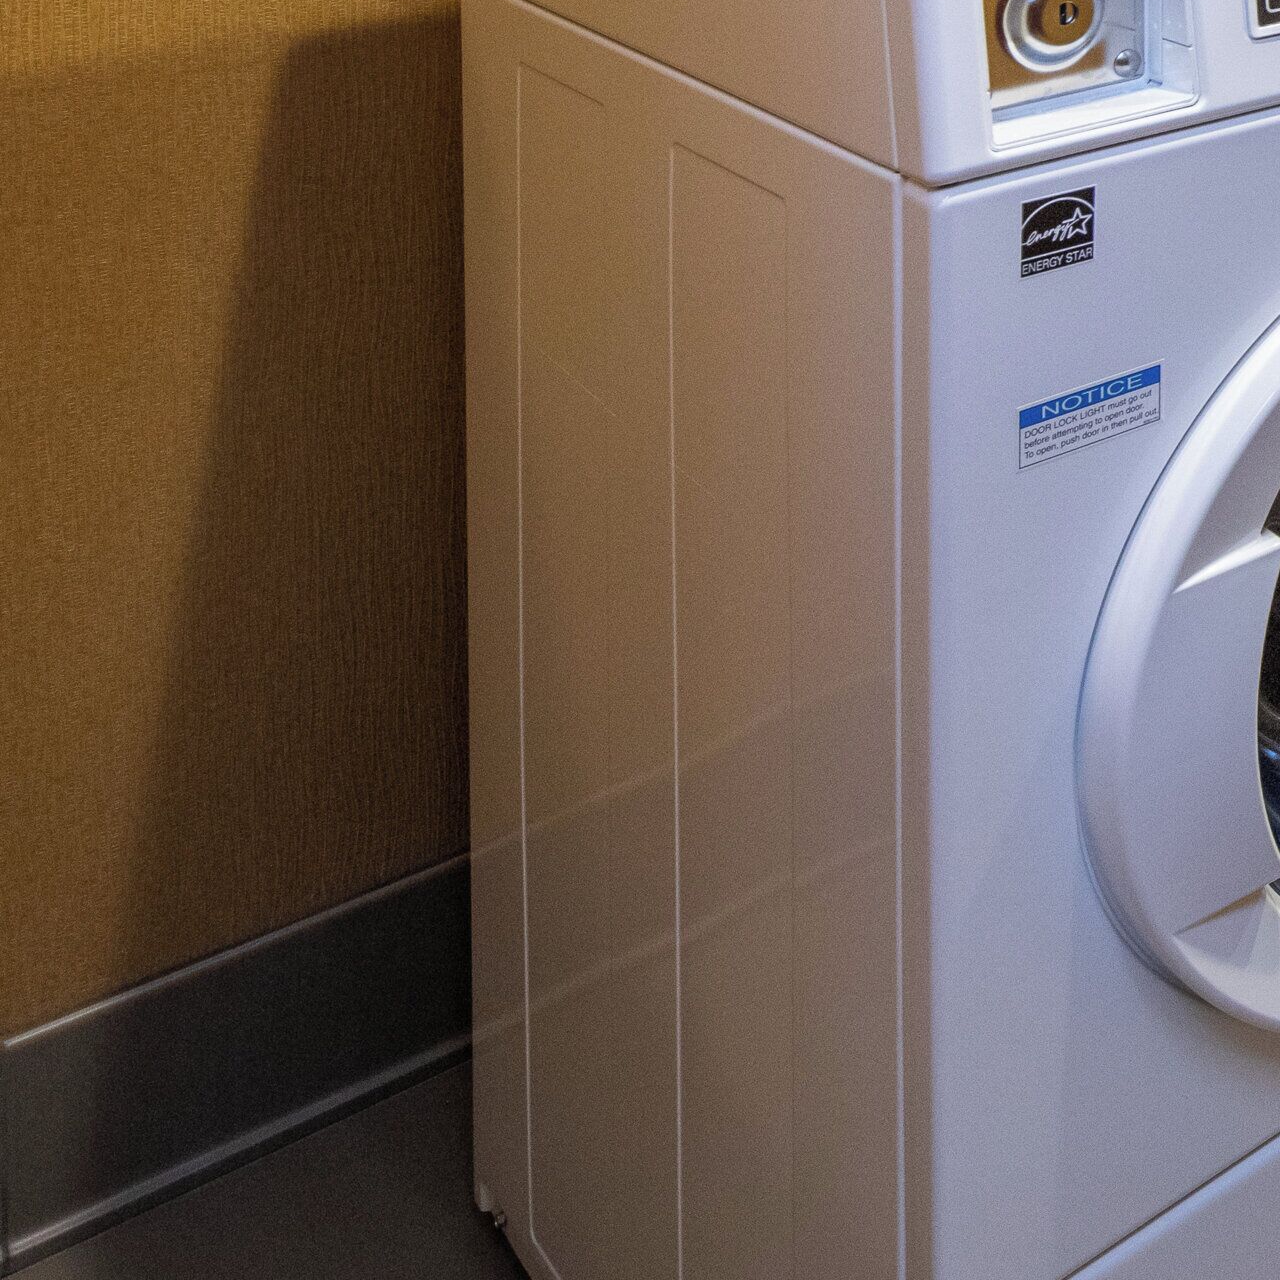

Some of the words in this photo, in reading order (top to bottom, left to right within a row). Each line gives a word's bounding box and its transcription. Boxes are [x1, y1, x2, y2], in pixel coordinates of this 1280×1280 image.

[1021, 254, 1063, 274] ENERGY
[1065, 246, 1092, 263] STAR
[1024, 423, 1051, 439] DOOR
[1053, 414, 1077, 428] LOCK
[1079, 404, 1105, 420] LIGHT
[1107, 398, 1126, 410] must
[1127, 395, 1138, 405] go
[1139, 389, 1152, 399] out
[1041, 373, 1142, 418] NOTICE
[1024, 435, 1050, 449] before
[1051, 420, 1093, 440] attempting
[1104, 410, 1124, 421] open
[1125, 403, 1143, 414] door.
[1024, 450, 1033, 458] To
[1035, 443, 1058, 455] open,
[1060, 435, 1080, 448] push
[1081, 427, 1099, 439] door
[1110, 418, 1127, 429] then
[1129, 411, 1143, 424] pull
